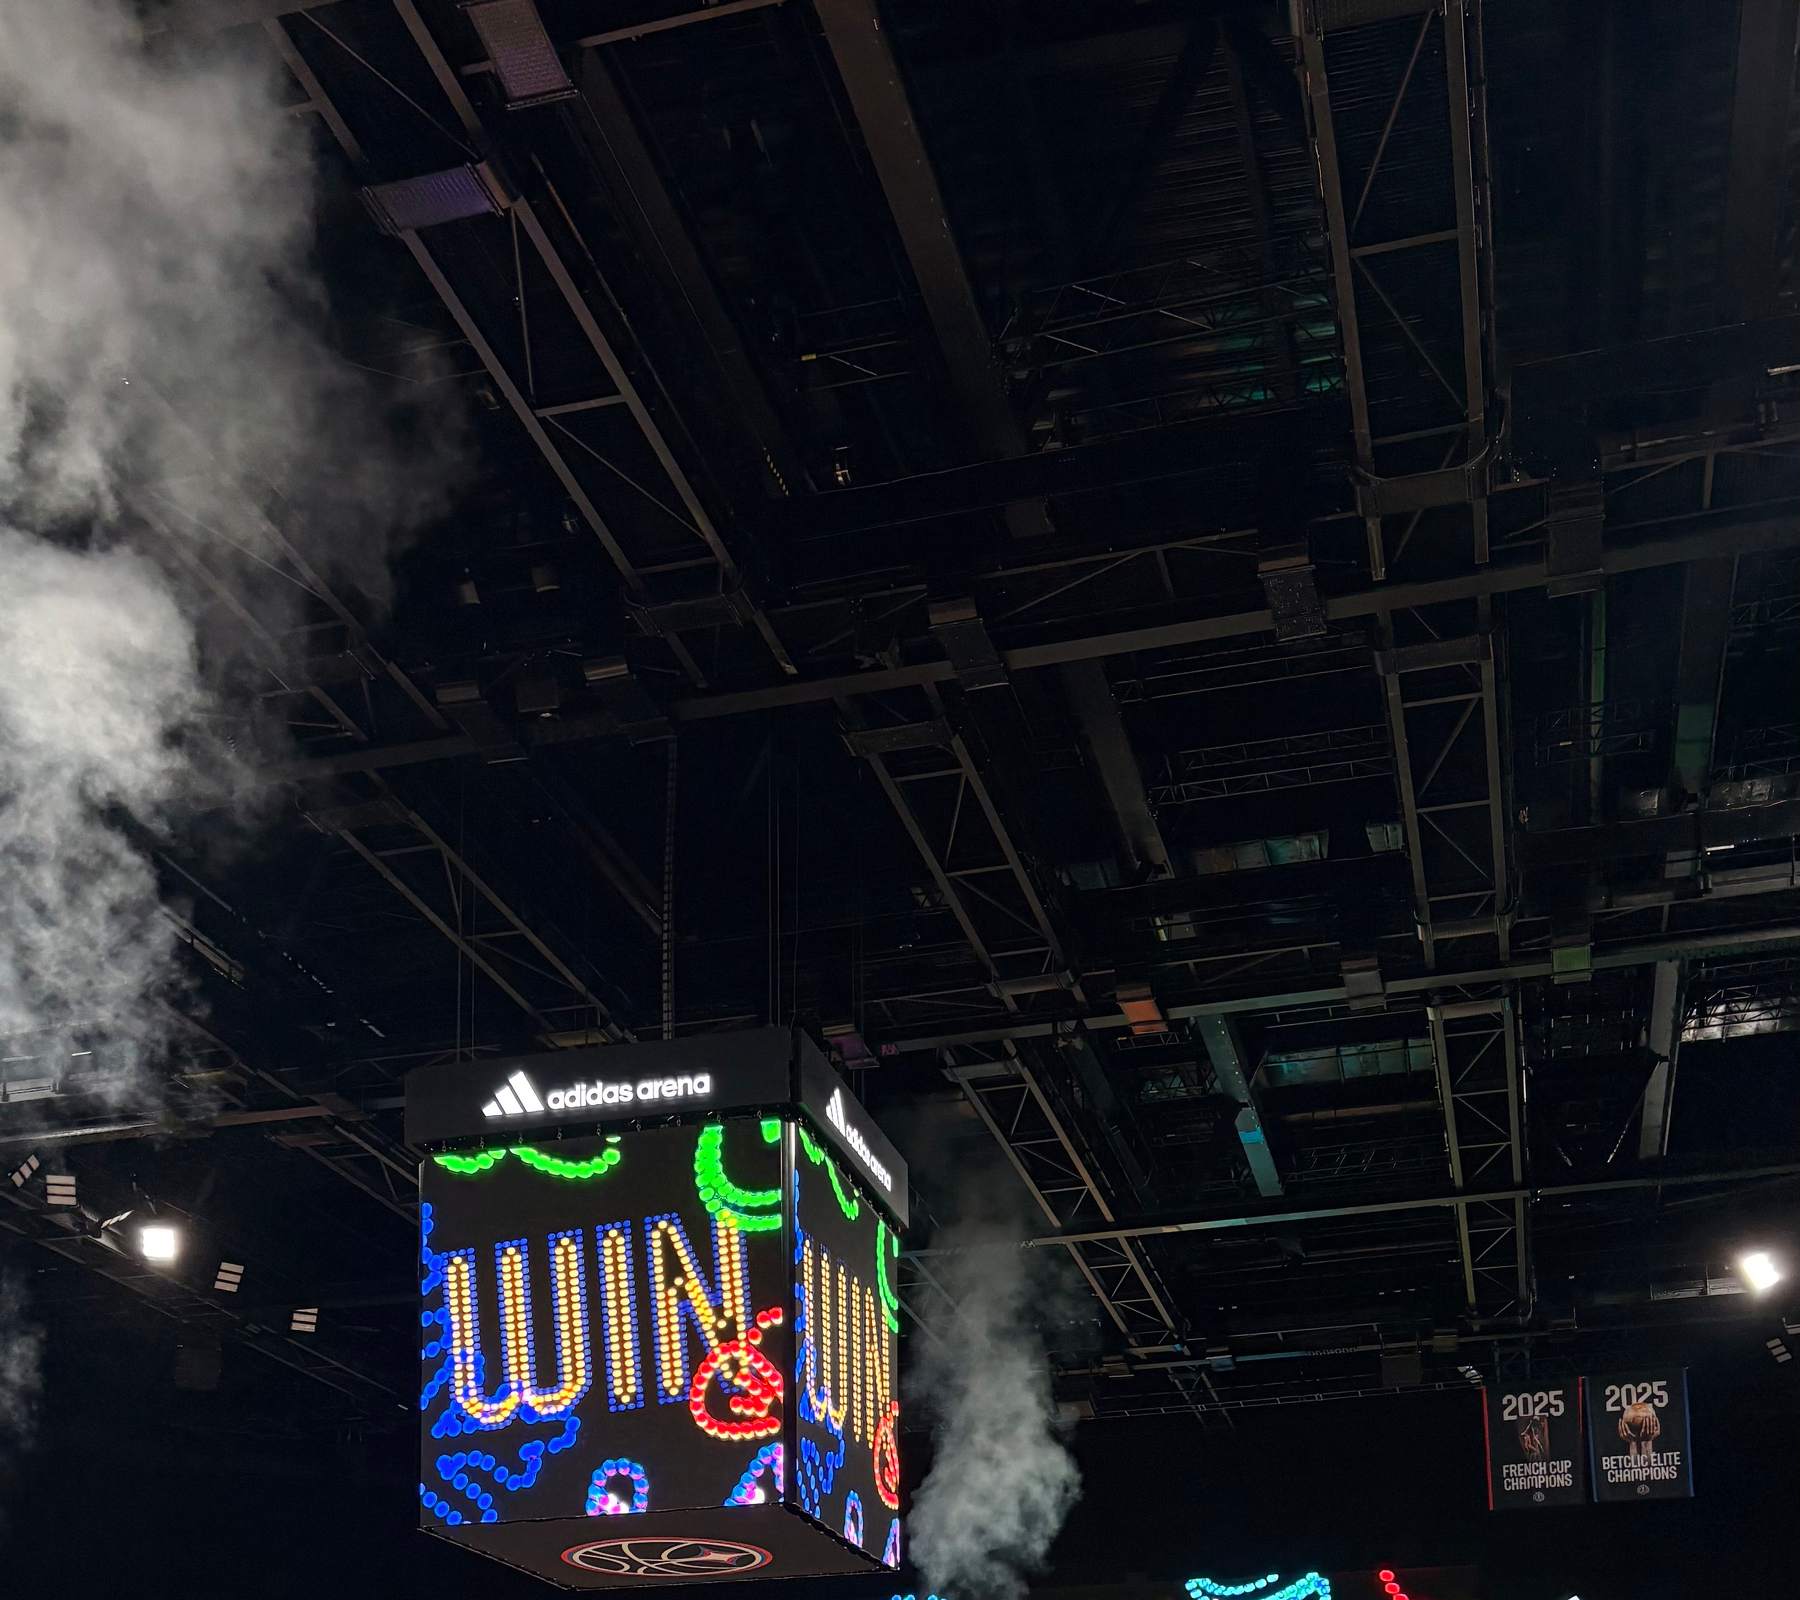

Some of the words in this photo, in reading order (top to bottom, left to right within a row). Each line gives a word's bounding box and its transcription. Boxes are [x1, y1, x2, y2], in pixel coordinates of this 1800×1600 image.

[546, 1081, 634, 1111] adidas
[635, 1073, 711, 1101] arena
[845, 1124, 871, 1168] adidas
[870, 1154, 892, 1193] arena
[442, 1211, 753, 1431] WIN
[802, 1236, 890, 1450] WIN
[1501, 1389, 1565, 1421] 2025
[1604, 1380, 1669, 1412] 2025
[1502, 1462, 1547, 1478] FRENCH
[1548, 1459, 1573, 1474] CUP
[1601, 1454, 1649, 1470] BETCLIC
[1607, 1465, 1678, 1484] CHAMPIONS
[1503, 1473, 1573, 1491] CHAMPIONS
